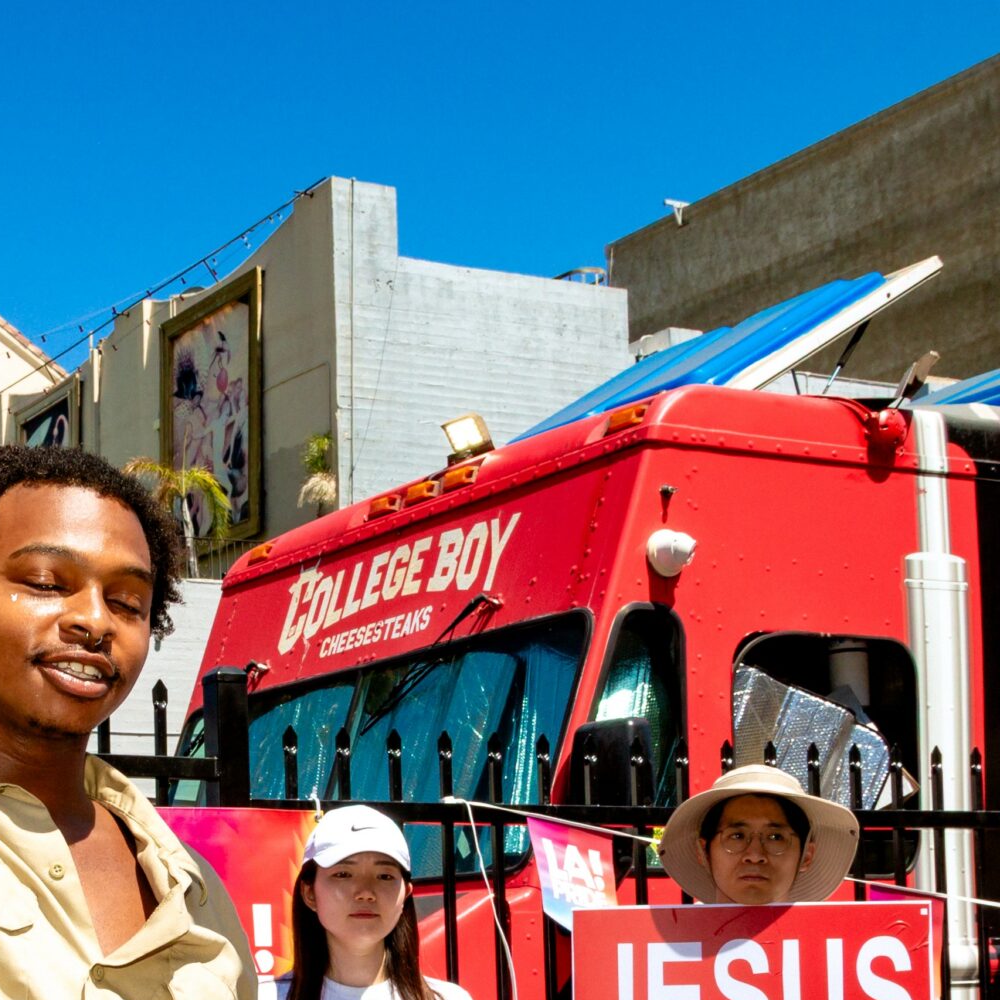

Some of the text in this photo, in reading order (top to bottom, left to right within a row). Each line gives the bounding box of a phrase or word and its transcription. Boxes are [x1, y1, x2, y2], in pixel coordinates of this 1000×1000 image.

[278, 512, 522, 656] COLLEGE BOY
[319, 605, 434, 659] CHEESESTEAKS
[542, 837, 605, 891] LA!
